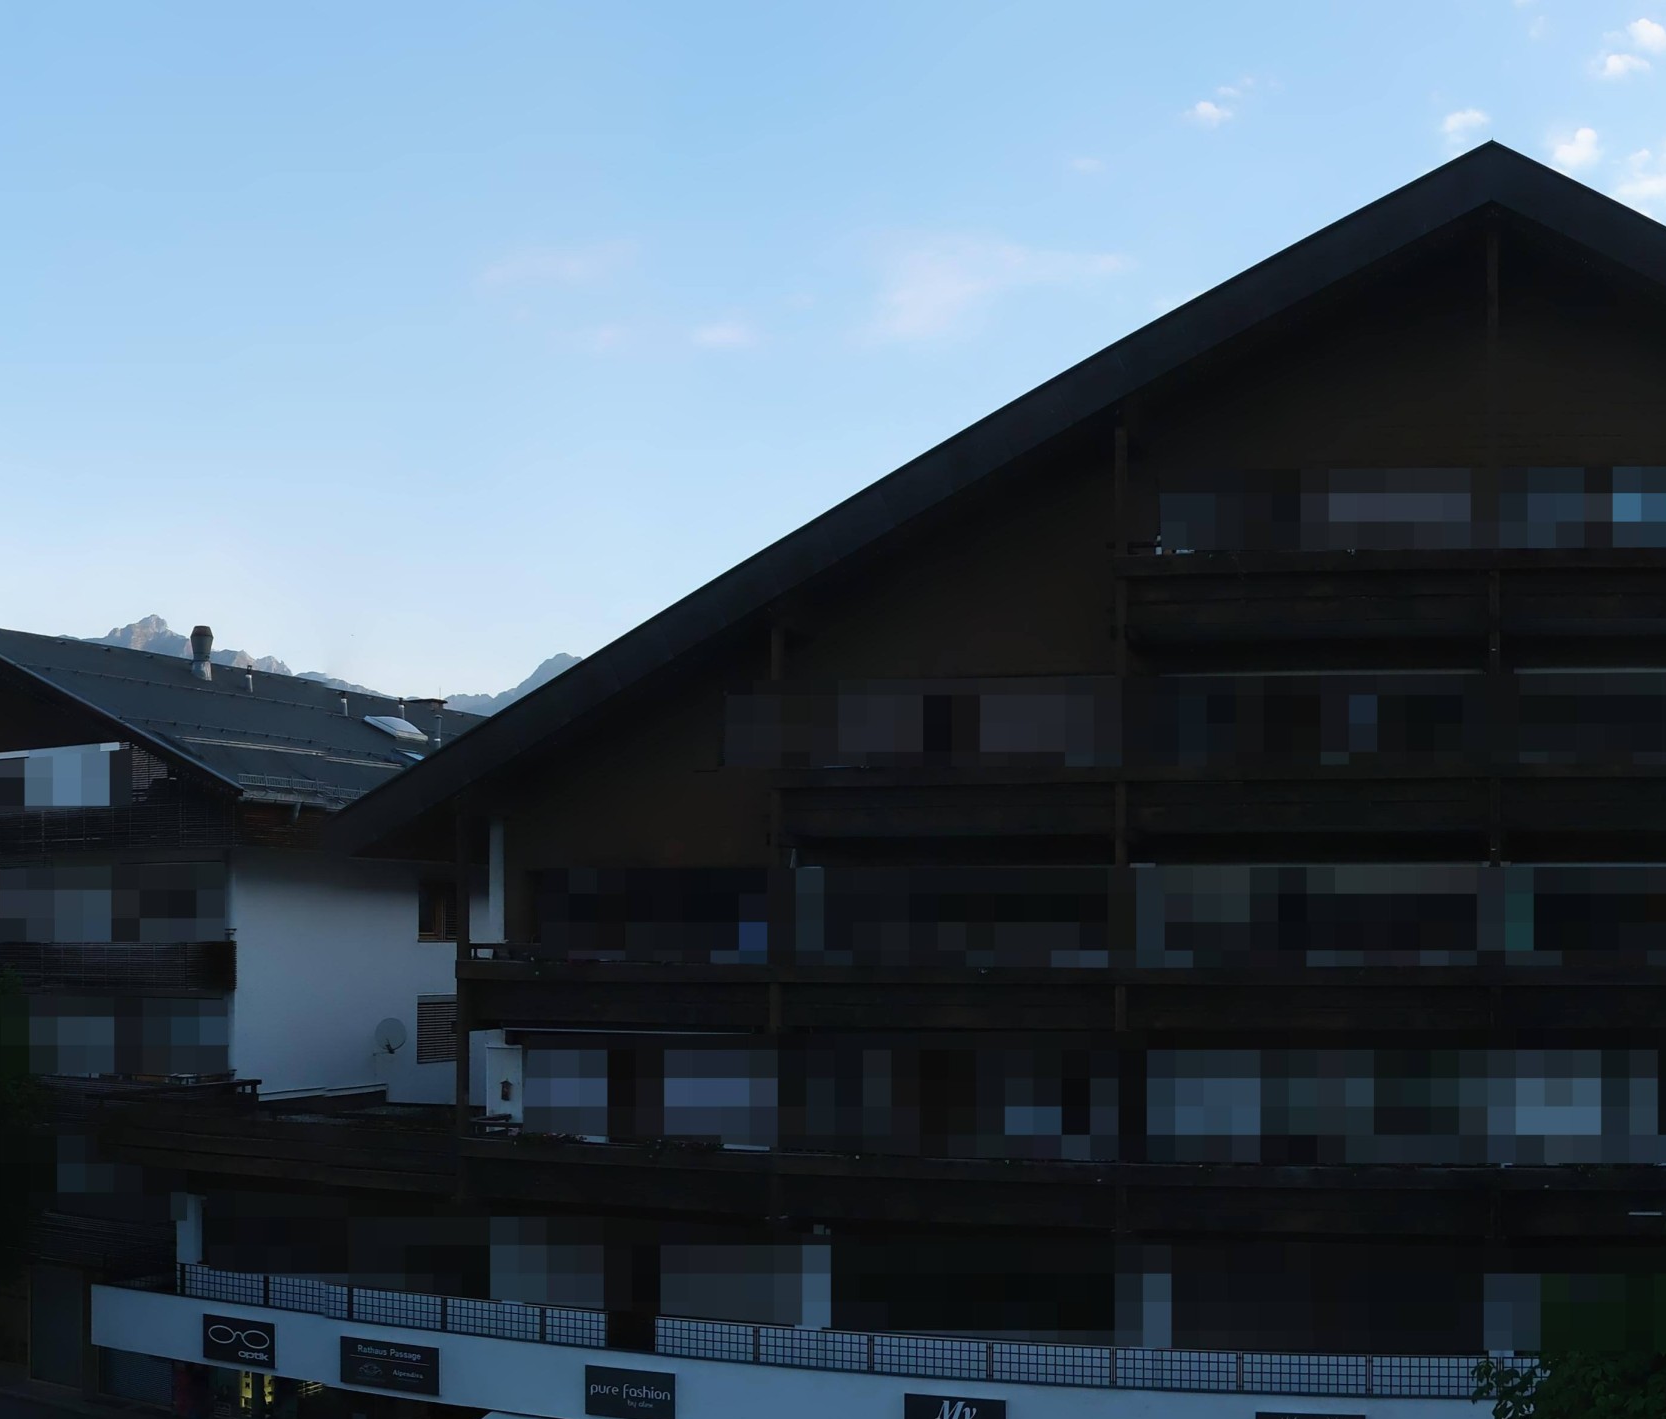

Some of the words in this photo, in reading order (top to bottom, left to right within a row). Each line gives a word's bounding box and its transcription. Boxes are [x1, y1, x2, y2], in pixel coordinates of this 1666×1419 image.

[237, 1349, 270, 1362] optik
[357, 1344, 387, 1356] Rathaus
[389, 1348, 422, 1361] Passage
[590, 1383, 619, 1396] pure
[623, 1383, 671, 1401] fashion
